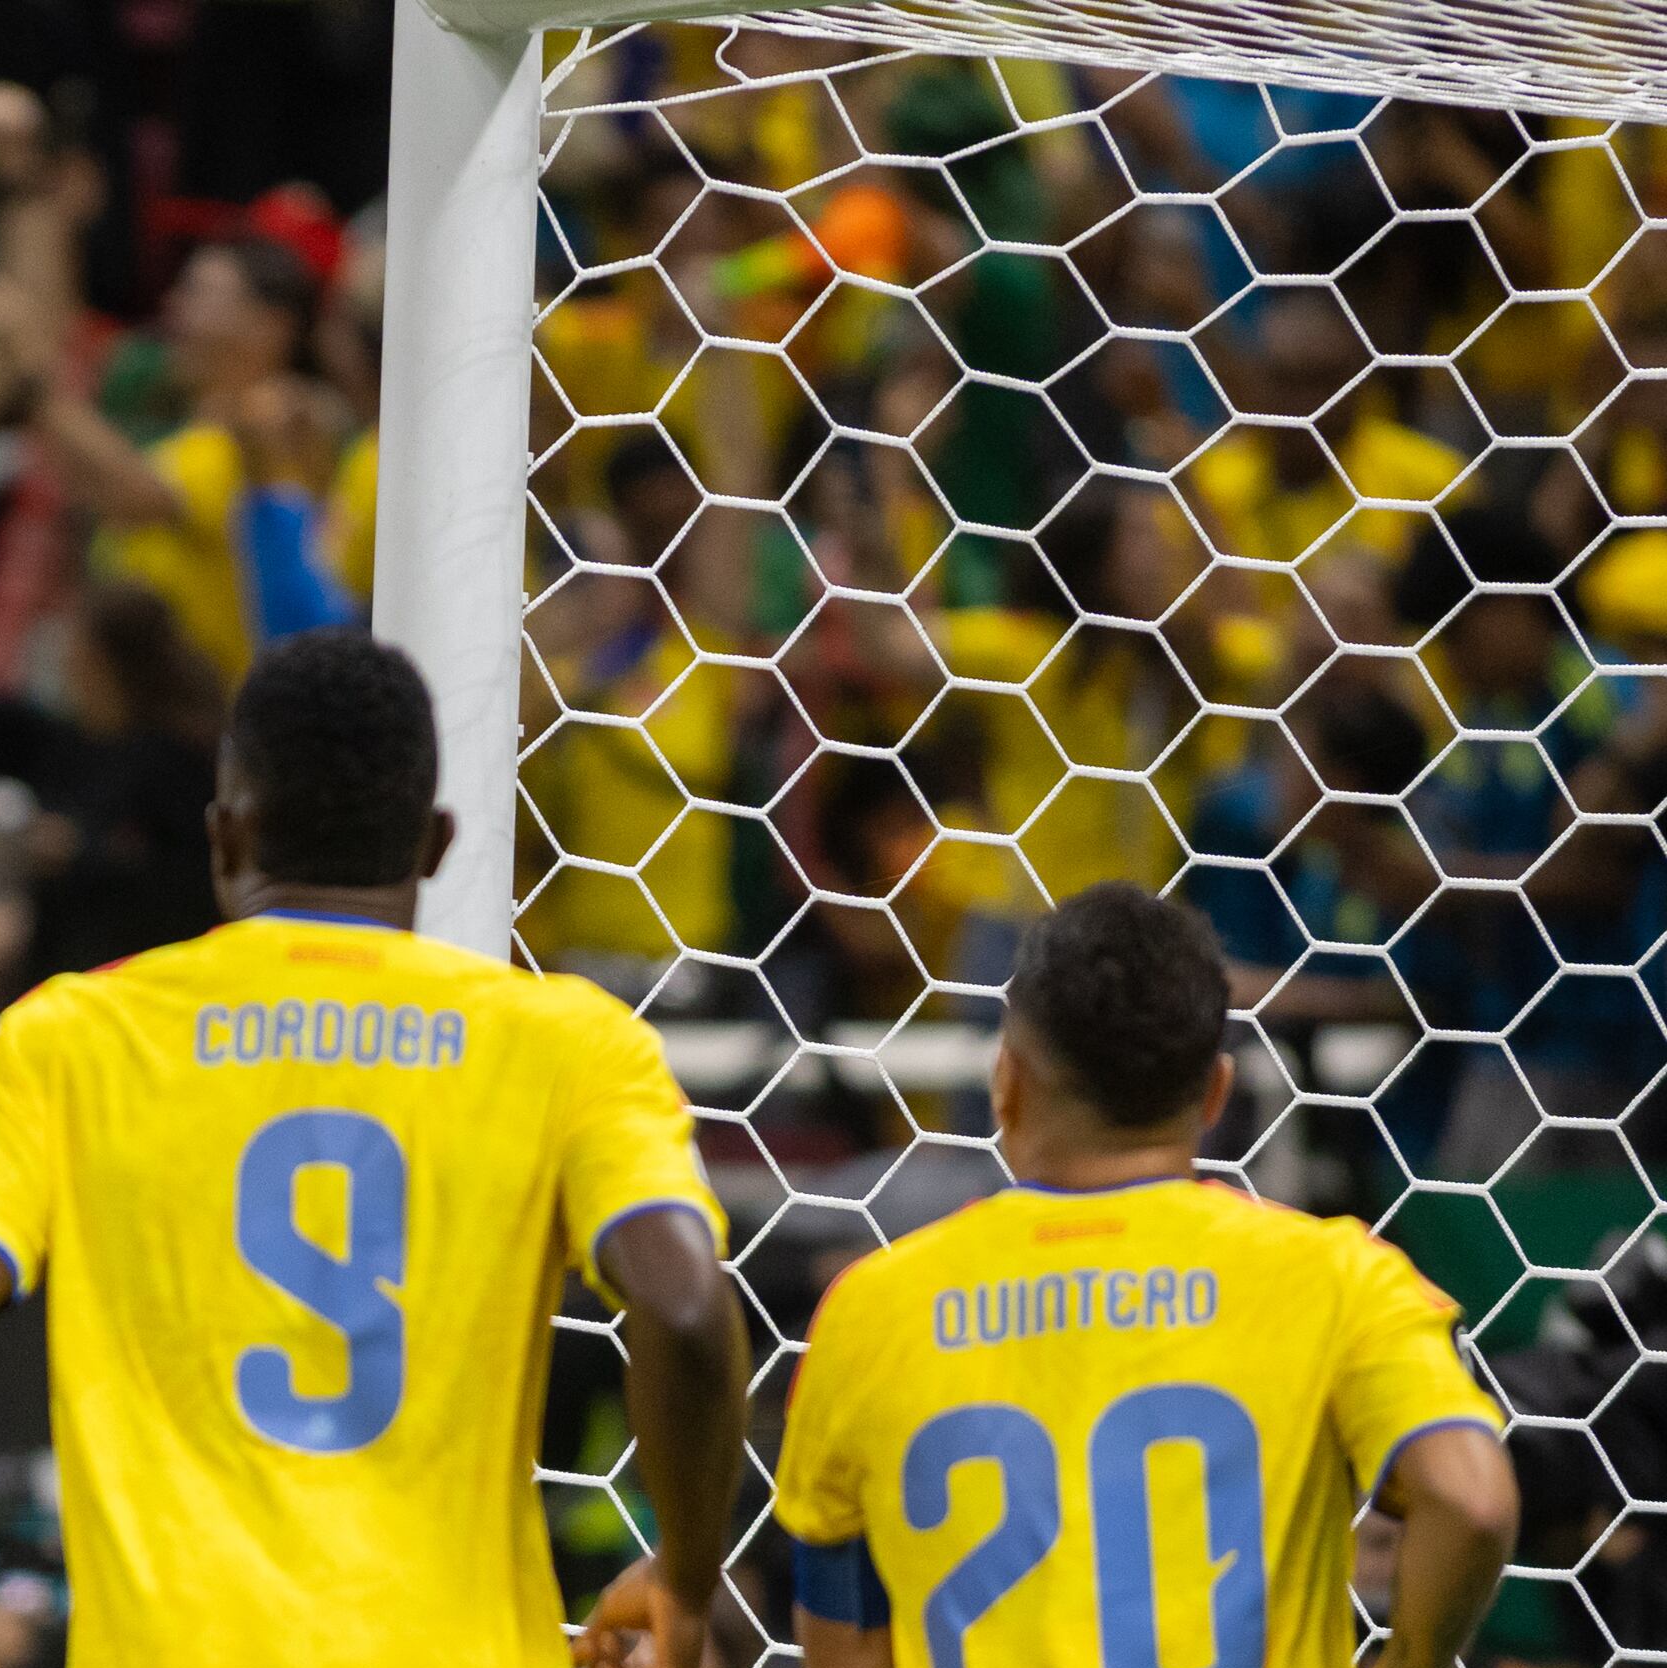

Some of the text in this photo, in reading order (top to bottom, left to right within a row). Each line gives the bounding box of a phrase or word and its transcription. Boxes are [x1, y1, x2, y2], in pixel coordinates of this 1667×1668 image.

[193, 997, 466, 1070] CORDOBA
[234, 1108, 408, 1453] 9
[933, 1264, 1220, 1352] QUINTERO
